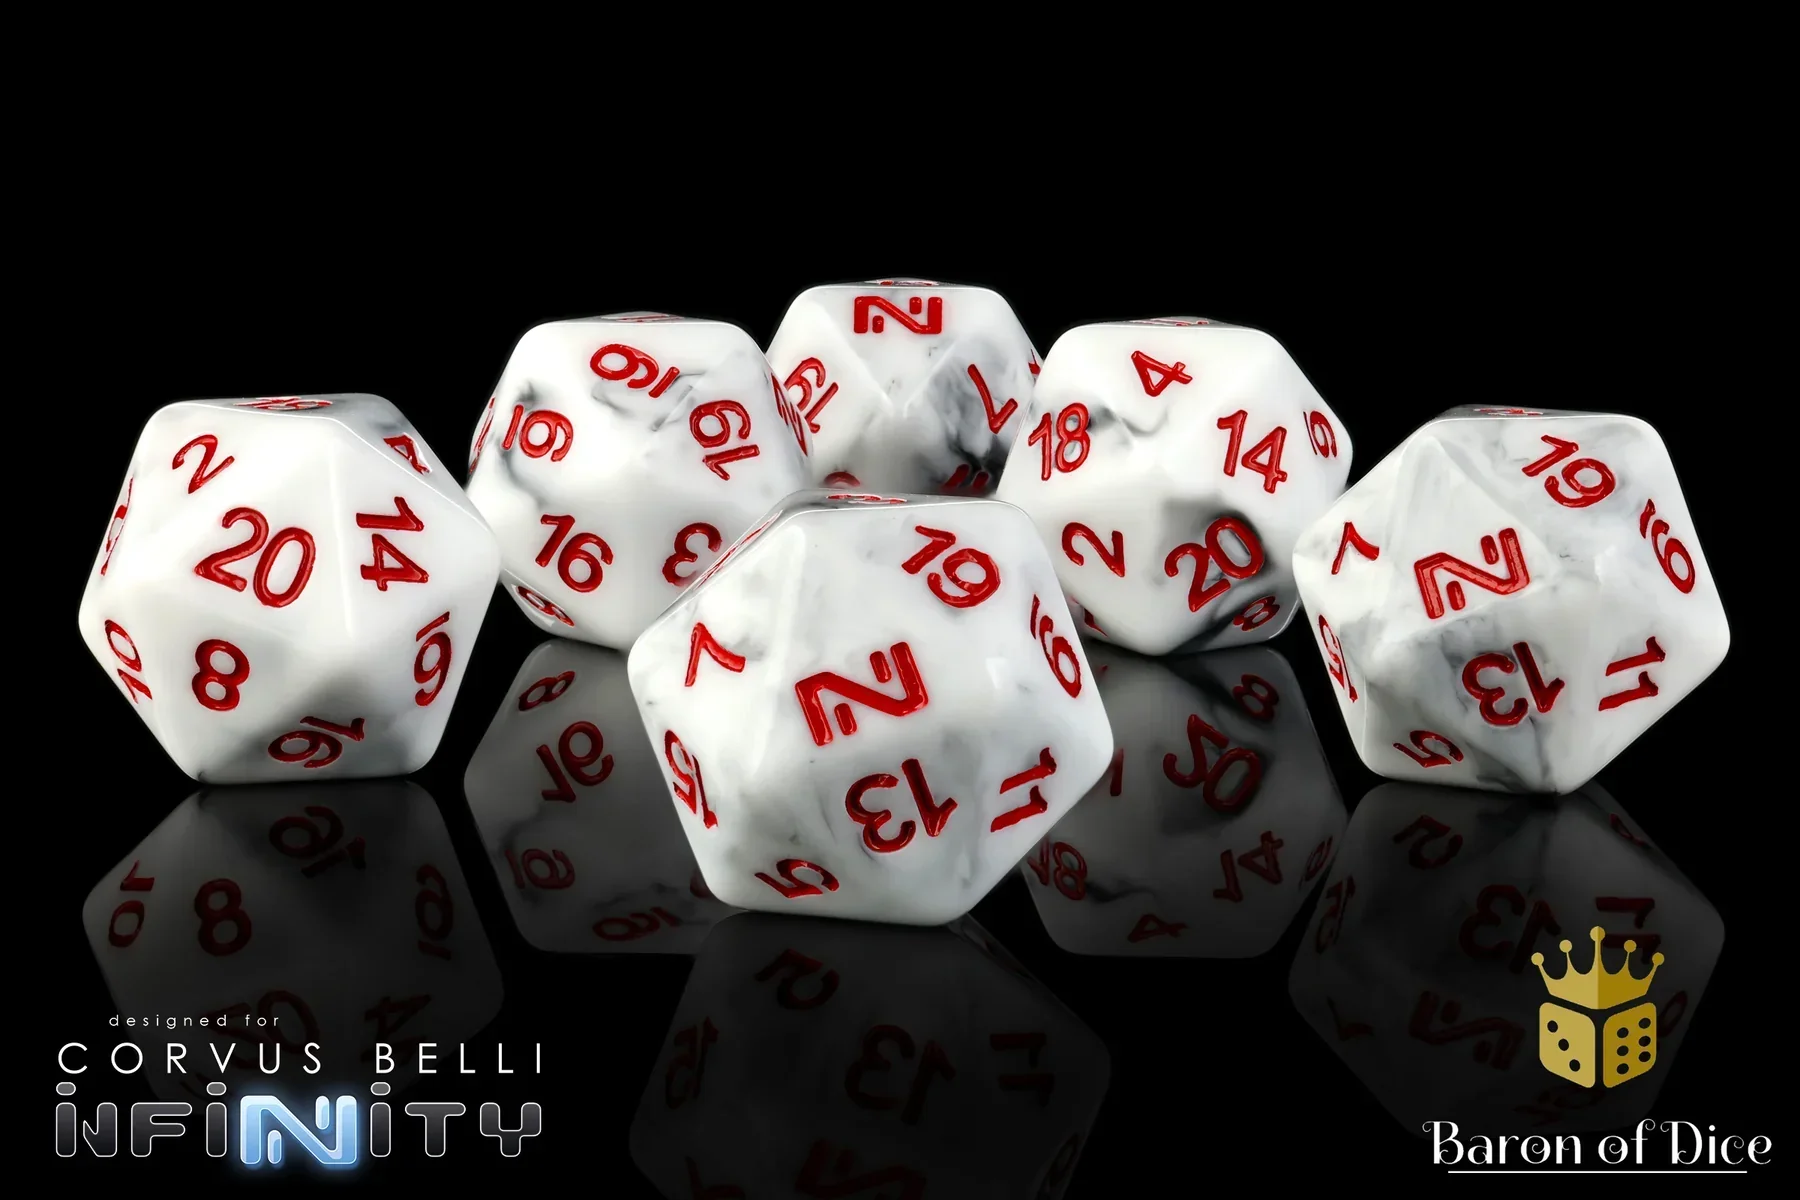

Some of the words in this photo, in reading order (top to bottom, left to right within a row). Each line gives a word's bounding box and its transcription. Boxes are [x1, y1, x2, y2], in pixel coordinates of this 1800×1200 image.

[1131, 351, 1192, 396] 4
[173, 435, 234, 493] 2
[384, 432, 430, 475] 4
[690, 400, 759, 480] 19
[1028, 402, 1090, 480] 18
[1218, 410, 1287, 493] 14
[1522, 435, 1615, 507] 19
[195, 508, 315, 607] 20
[356, 497, 428, 591] 14
[535, 515, 613, 592] 16
[662, 522, 722, 586] 3
[902, 525, 1000, 608] 19
[1062, 522, 1125, 577] 2
[1165, 517, 1265, 612] 20
[1331, 522, 1379, 575] 7
[104, 619, 152, 704] 10
[192, 639, 249, 711] 8
[685, 622, 745, 687] 7
[1462, 642, 1565, 726] 13
[1598, 636, 1666, 711] 11
[664, 730, 718, 829] 15
[1393, 730, 1463, 768] 5
[845, 759, 957, 853] 13
[990, 747, 1057, 833] 11
[755, 859, 839, 898] 5
